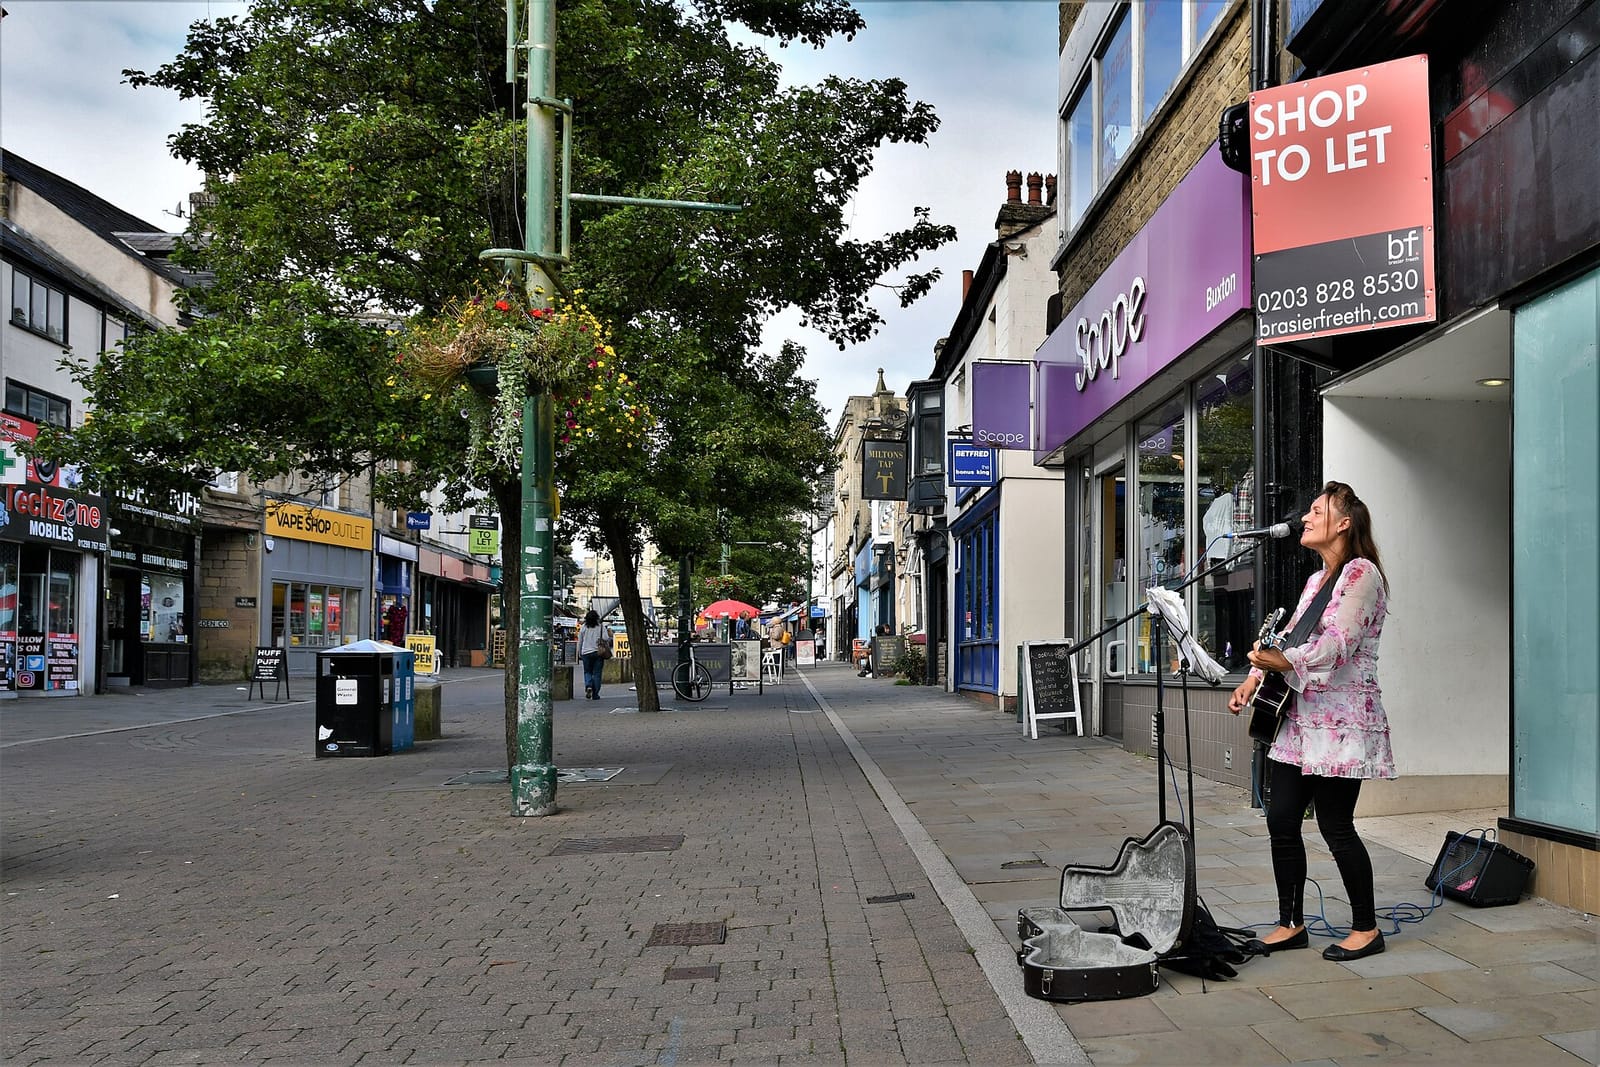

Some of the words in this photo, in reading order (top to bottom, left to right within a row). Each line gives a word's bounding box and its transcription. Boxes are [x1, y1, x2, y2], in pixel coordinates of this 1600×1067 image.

[1254, 84, 1368, 141] SHOP
[1254, 144, 1311, 186] TO
[1325, 125, 1393, 174] LET
[1206, 273, 1236, 313] Buxton
[1257, 286, 1308, 313] 0203
[1315, 278, 1355, 304] 828
[1362, 269, 1419, 297] 8530
[1258, 301, 1419, 337] brasierfreeth.com
[1074, 276, 1147, 393] Scope
[978, 430, 1025, 446] Scope
[868, 450, 904, 459] MILTONS
[878, 460, 894, 468] TAP
[5, 484, 101, 529] Techzone
[29, 520, 74, 542] MOBILES
[275, 511, 303, 530] VAPE
[305, 516, 331, 534] SHOP
[332, 521, 365, 540] OUTLET
[477, 530, 491, 539] TO
[476, 538, 492, 546] LET
[17, 636, 44, 644] OLLOW
[617, 640, 629, 649] NO
[257, 649, 281, 657] HUFF
[410, 643, 431, 653] NOW
[616, 650, 632, 658] OPE
[414, 654, 432, 663] PEN
